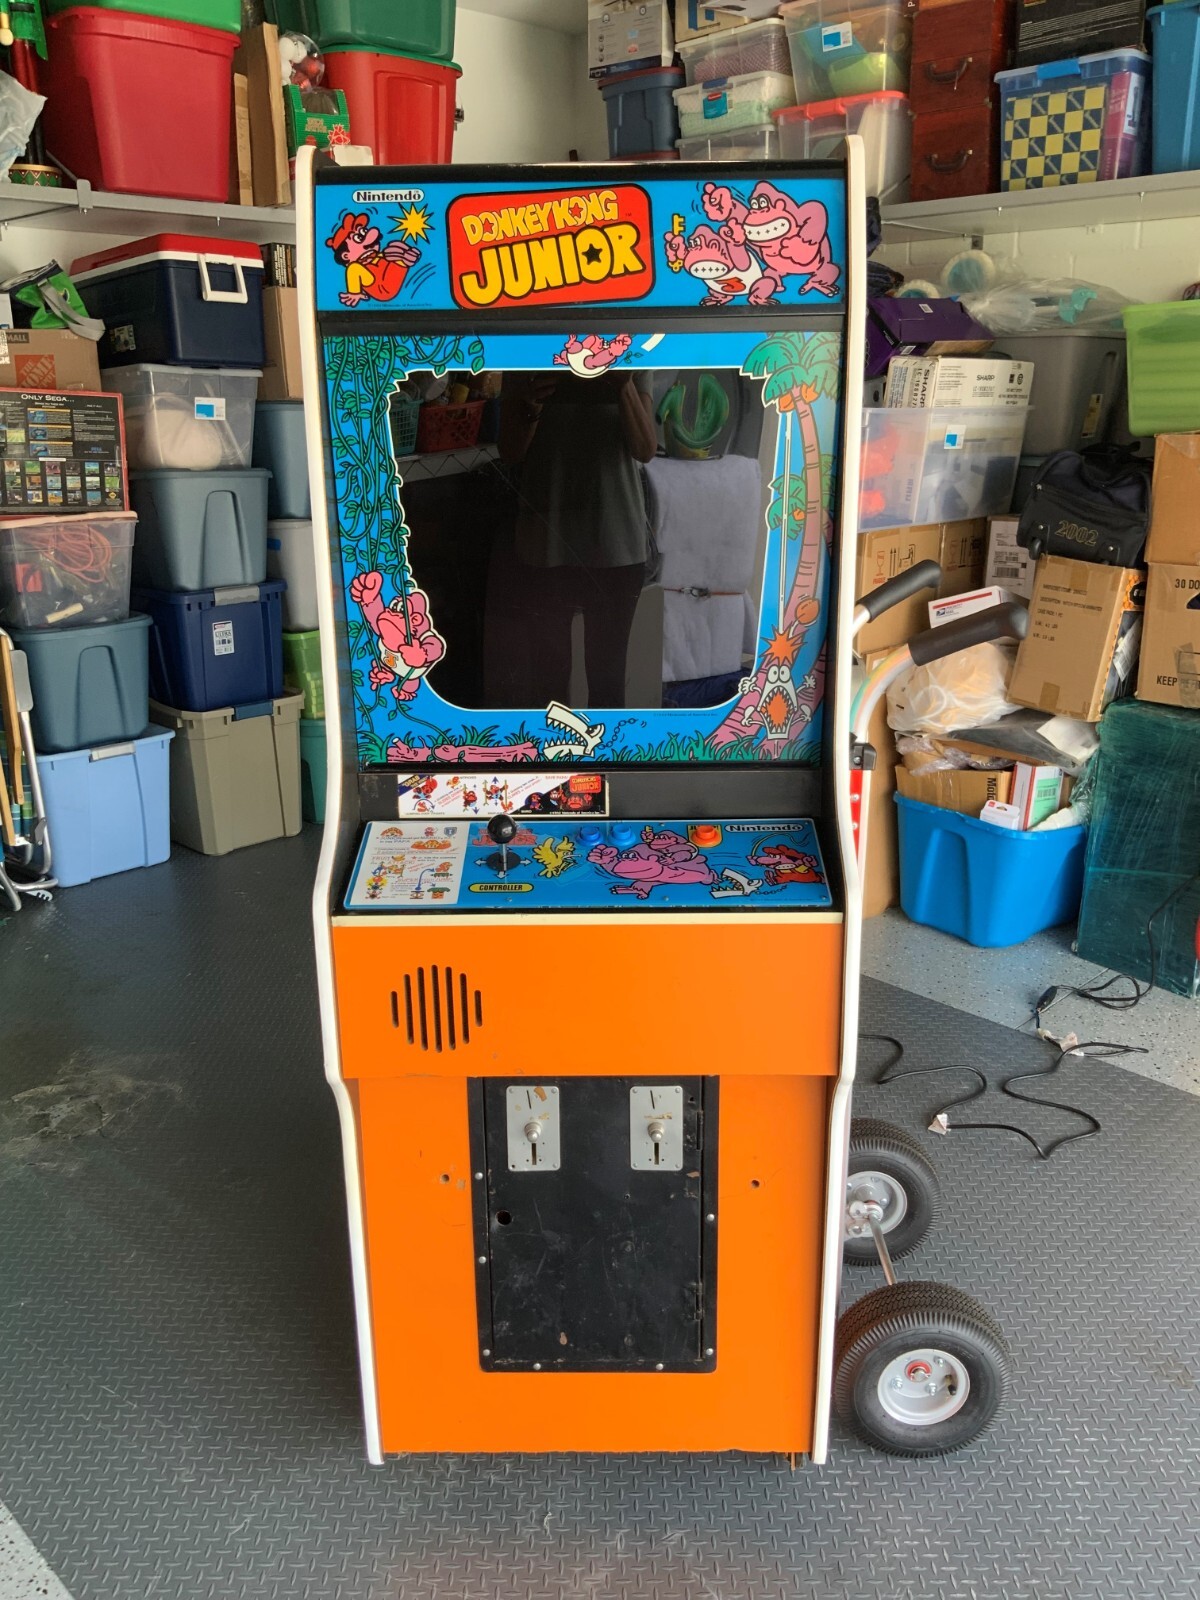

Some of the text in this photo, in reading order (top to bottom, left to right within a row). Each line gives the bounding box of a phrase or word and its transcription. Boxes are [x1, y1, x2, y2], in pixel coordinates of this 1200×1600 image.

[356, 189, 421, 202] Nintendo
[461, 190, 619, 246] DONKEY KONG
[459, 224, 647, 305] JUNIOR
[6, 332, 28, 342] MALL
[920, 369, 930, 408] SHARP
[20, 393, 44, 401] ONLY
[1054, 519, 1099, 547] 2002
[1174, 578, 1186, 589] 30
[1156, 674, 1178, 687] KEEP
[729, 823, 802, 832] Nintendo
